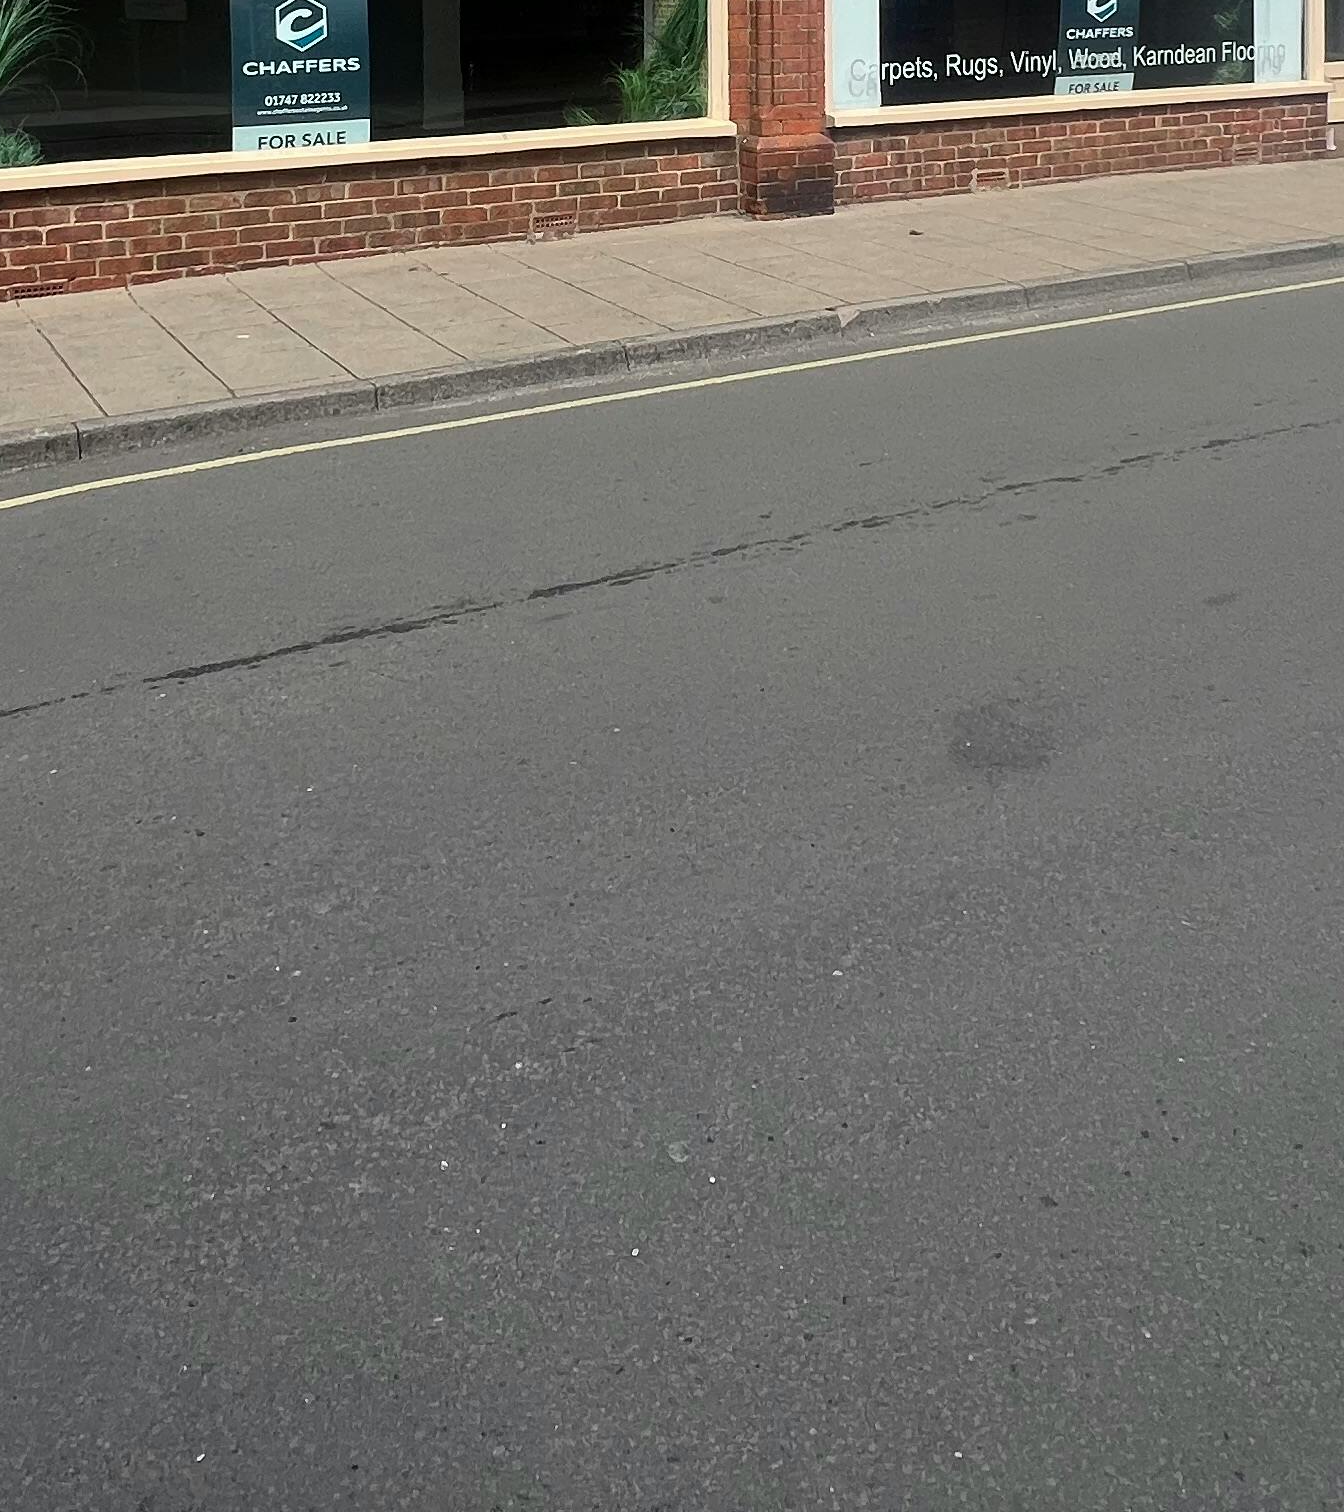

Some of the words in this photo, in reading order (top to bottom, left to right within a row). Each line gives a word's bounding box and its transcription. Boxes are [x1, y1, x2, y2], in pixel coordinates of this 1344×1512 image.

[1065, 25, 1134, 40] CHAFFERS
[241, 57, 361, 77] CHAFFERS
[945, 54, 1004, 81] Rugs,
[1010, 49, 1062, 77] Vinyl,
[1068, 46, 1127, 70] Wood,
[1132, 43, 1216, 68] Karndean
[1068, 82, 1091, 95] FOR
[1093, 81, 1120, 93] SALE
[264, 94, 299, 107] 01747
[299, 92, 341, 105] 822233
[258, 135, 296, 151] FOR
[301, 130, 347, 147] SALE
